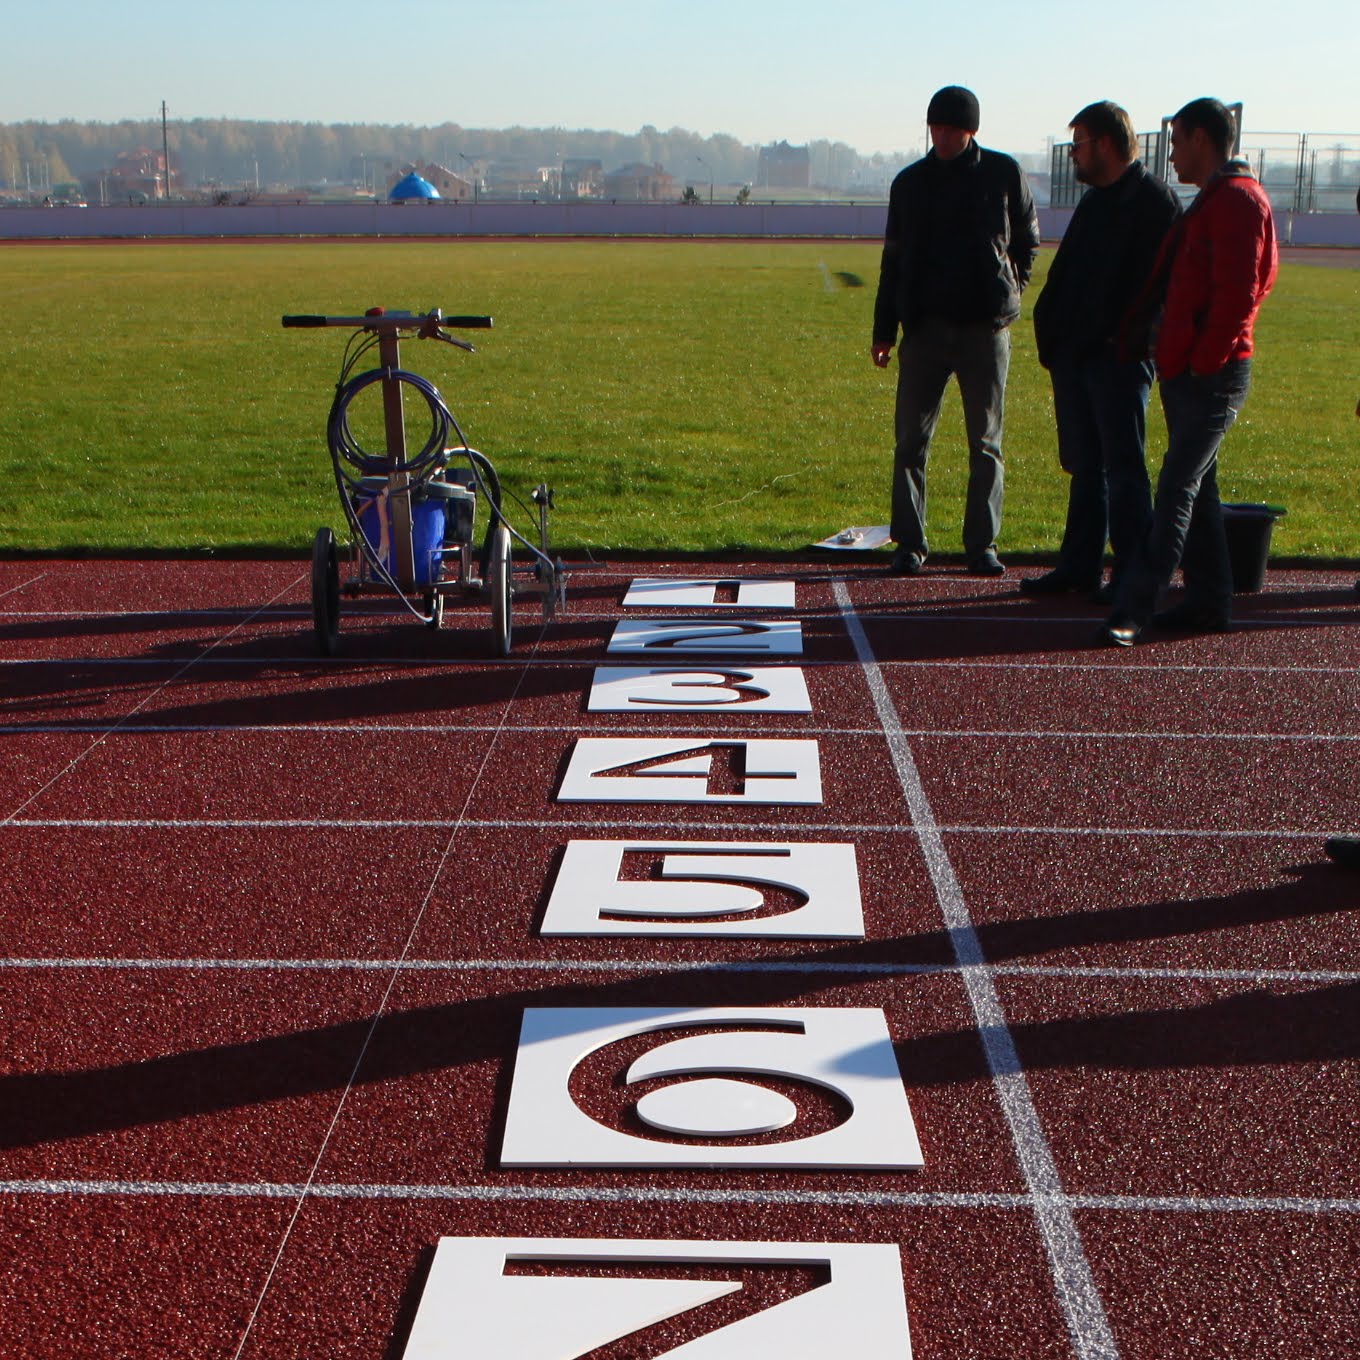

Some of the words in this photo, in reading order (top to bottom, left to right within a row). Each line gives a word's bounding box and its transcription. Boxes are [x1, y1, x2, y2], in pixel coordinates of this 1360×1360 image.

[692, 580, 741, 604] 1
[643, 621, 772, 649] 2
[628, 669, 771, 706] 3
[589, 741, 798, 796] 4
[597, 846, 810, 924] 5
[567, 1017, 855, 1148] 6
